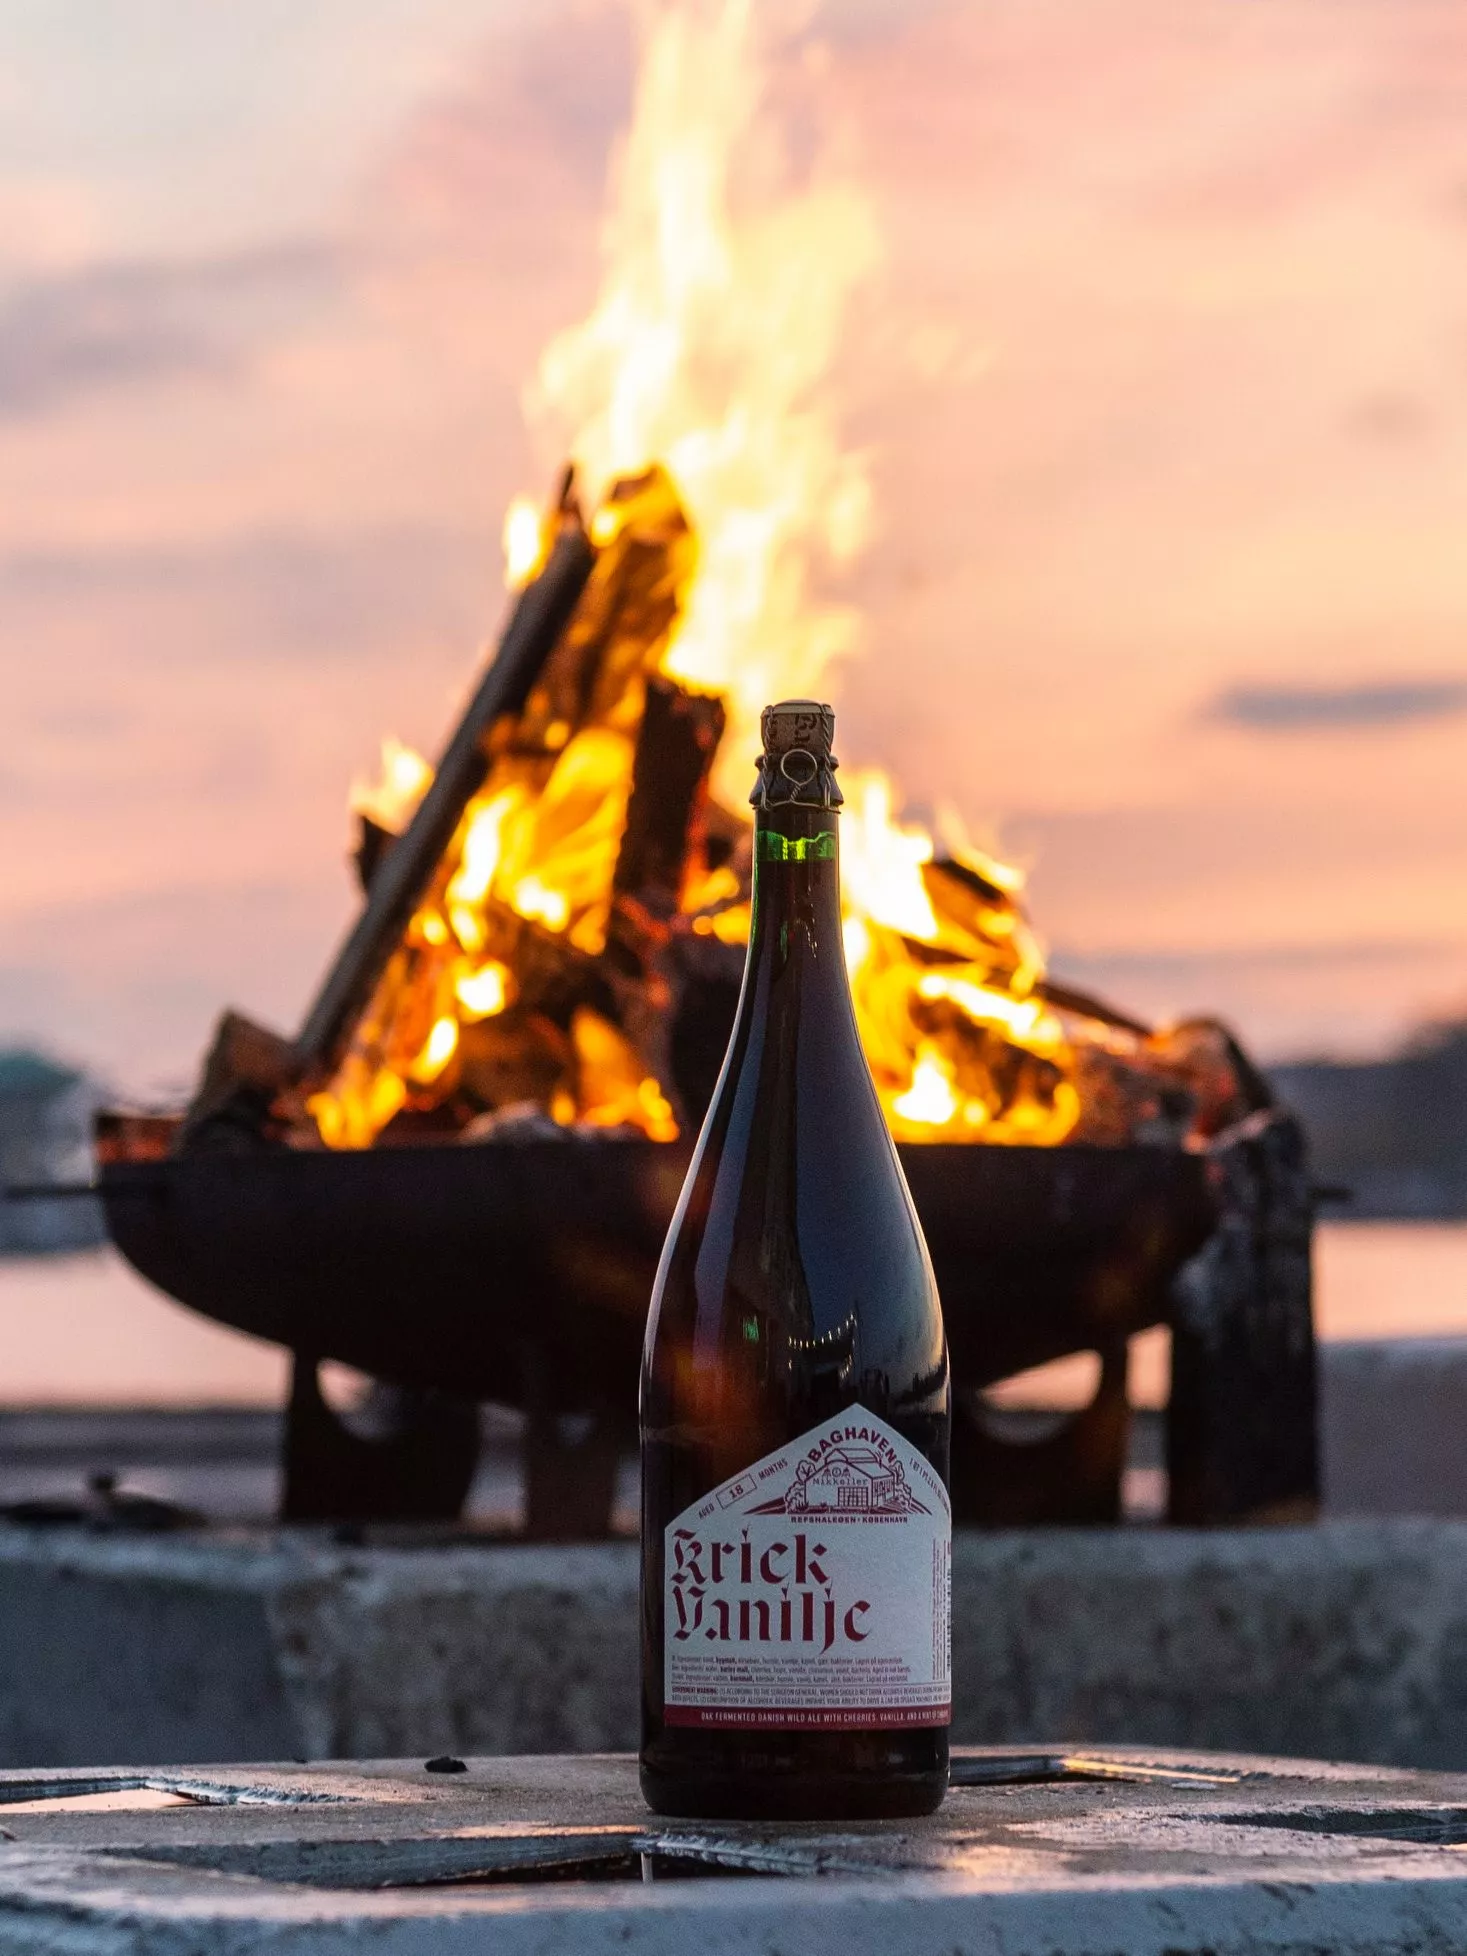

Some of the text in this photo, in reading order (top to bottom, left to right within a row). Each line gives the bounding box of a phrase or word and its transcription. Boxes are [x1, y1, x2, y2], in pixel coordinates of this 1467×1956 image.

[808, 1427, 897, 1463] BAGHAVEN
[730, 1484, 744, 1498] 18
[758, 1458, 788, 1480] MONTHS
[812, 1478, 868, 1486] Mikkeller
[701, 1712, 714, 1721] OAK
[715, 1712, 756, 1722] FERMENTED
[757, 1713, 784, 1723] DANISH
[787, 1713, 805, 1723] WILD
[807, 1713, 821, 1723] ALE
[823, 1713, 841, 1723] WITH
